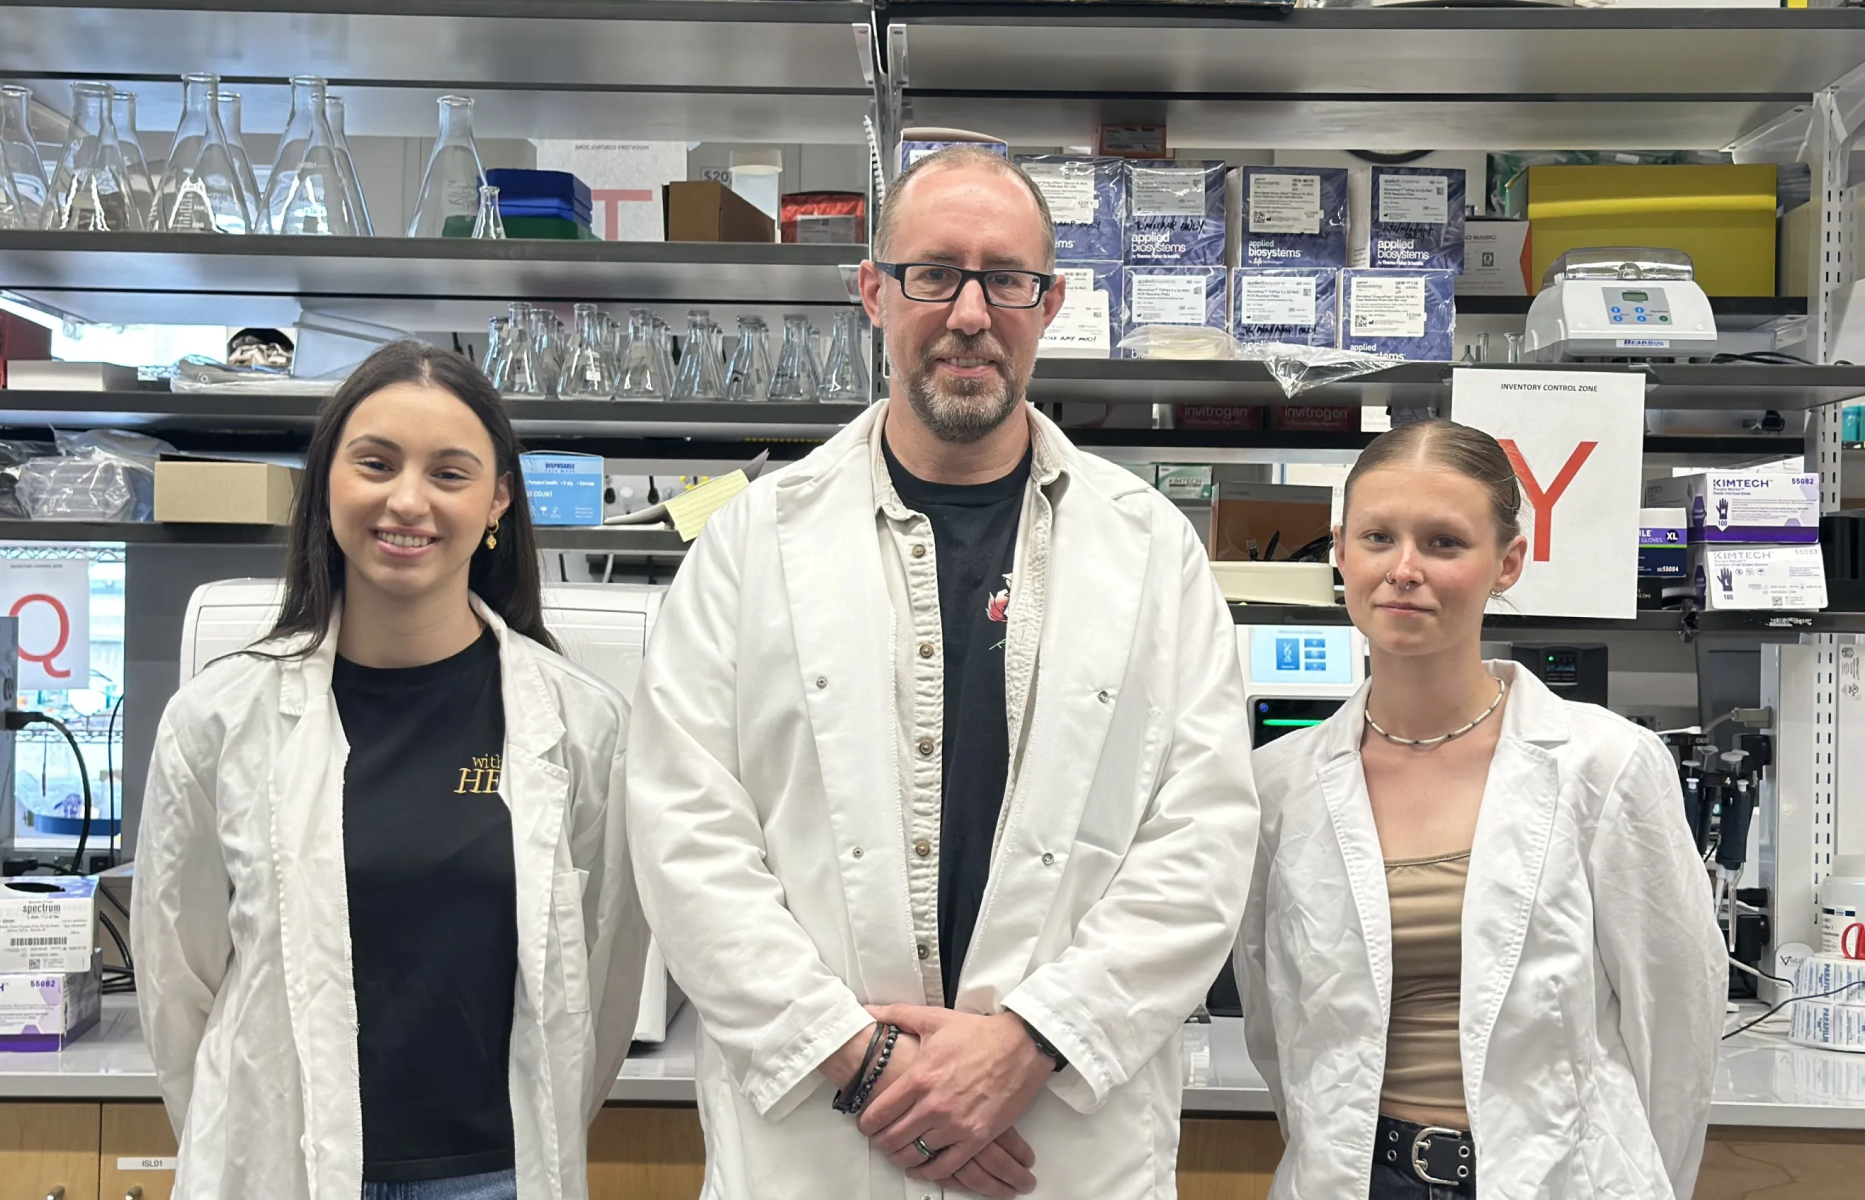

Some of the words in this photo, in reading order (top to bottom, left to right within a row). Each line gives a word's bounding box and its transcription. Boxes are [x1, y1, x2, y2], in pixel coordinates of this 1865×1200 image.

[1131, 232, 1170, 245] applied
[1131, 243, 1187, 255] biosystems
[1248, 240, 1275, 251] applied
[1378, 240, 1415, 251] applied
[1378, 248, 1430, 262] biosystems
[1501, 383, 1541, 391] INVENTORY
[1543, 384, 1577, 392] CONTROL
[1184, 405, 1248, 420] invitrogen
[1285, 405, 1347, 421] invitrogen
[1495, 438, 1598, 562] Y
[1666, 532, 1678, 540] XL
[9, 593, 71, 678] Q
[23, 904, 61, 914] spectrum
